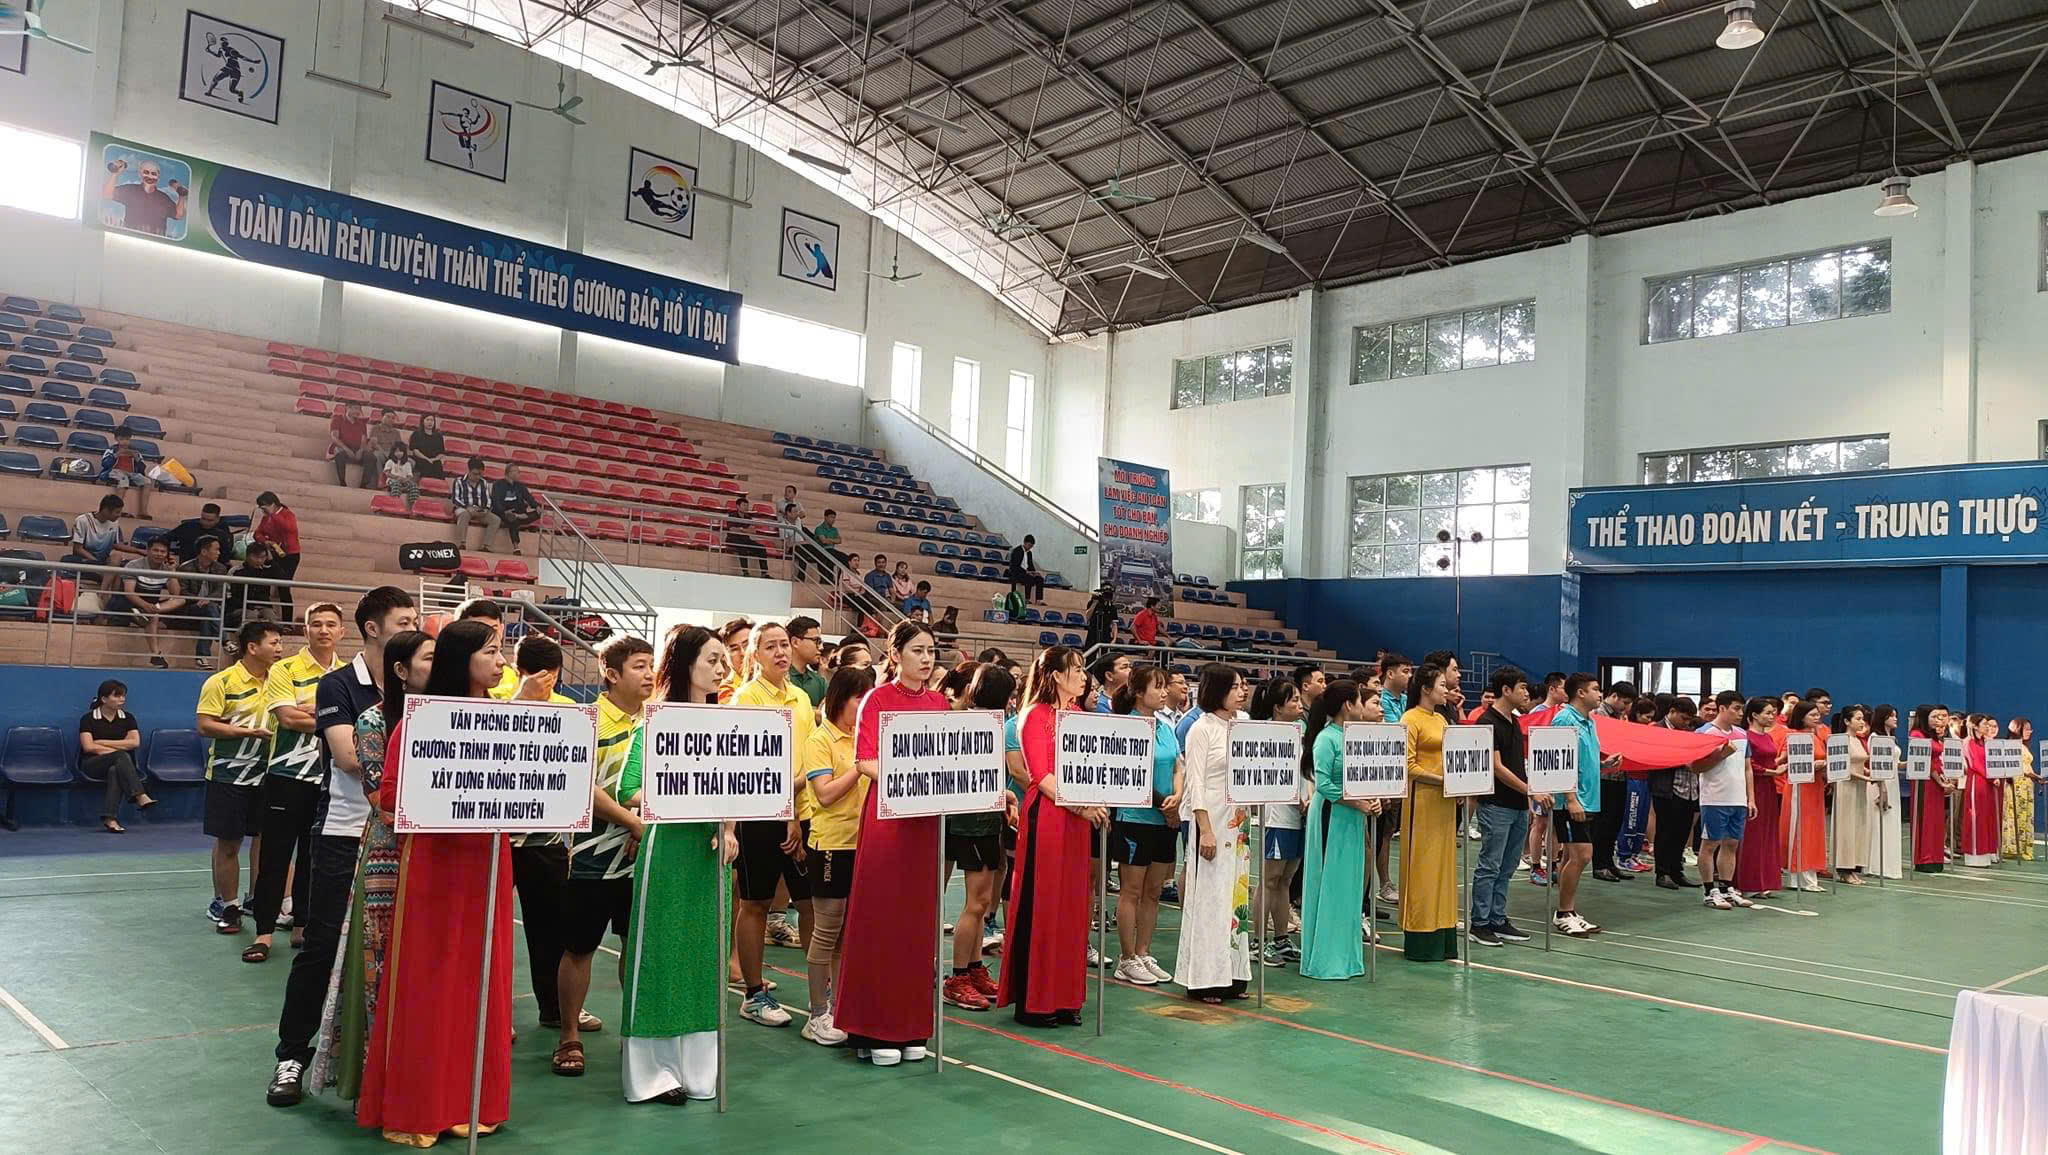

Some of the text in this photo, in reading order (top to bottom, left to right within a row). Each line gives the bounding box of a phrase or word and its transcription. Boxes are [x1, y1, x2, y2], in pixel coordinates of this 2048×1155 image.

[229, 195, 728, 351] TOÀN DÂN RÈN LUYỆN THÂN THỂ THEO GƯƠNG BÁC HỒ VĨ ĐẠI
[1587, 504, 1630, 548] THỂ
[1635, 513, 1696, 546] THAO
[1702, 503, 1772, 544] ĐOÀN
[1778, 495, 1828, 542] KẾT
[1855, 500, 1950, 539] TRUNG
[1958, 493, 2039, 543] THỰC
[426, 548, 456, 559] YONEX
[451, 709, 562, 734] VĂN PHÒNG ĐIỀU PHỐI
[412, 739, 588, 765] CHƯƠNG TRÌNH MỤC TIÊU QUỐC GIA
[656, 725, 783, 762] CHI CỤC KIỂM LÂM
[892, 733, 910, 758] BAN
[912, 724, 935, 760] QUẢN
[937, 728, 947, 757] LÝ
[948, 730, 960, 761] DỰ
[961, 727, 972, 755] ÁN
[1062, 733, 1077, 753] CHI
[1079, 734, 1097, 758] CỤC
[1128, 737, 1150, 761] TRỌT
[1231, 738, 1296, 762] CHI CỤC CHĂN NUÔI,
[1062, 757, 1147, 791] VÀ BẢO VỆ THỰC VẬT
[1233, 765, 1246, 786] THÚ
[1247, 769, 1252, 786] Y
[1253, 765, 1262, 786] VÀ
[1279, 762, 1294, 786] SẢN
[1446, 750, 1454, 774] CHI
[1455, 749, 1467, 778] CỤC
[1532, 744, 1574, 776] TRỌNG TÀI
[431, 768, 567, 793] XÂY DỰNG NÔNG THÔN MỚI
[656, 763, 782, 796] TỈNH THÁI NGUYÊN
[887, 766, 998, 798] CÁC CÔNG TRÌNH NN & PTNT
[451, 795, 545, 820] TỈNH THÁI NGUYÊN
[823, 862, 832, 882] YONEX
